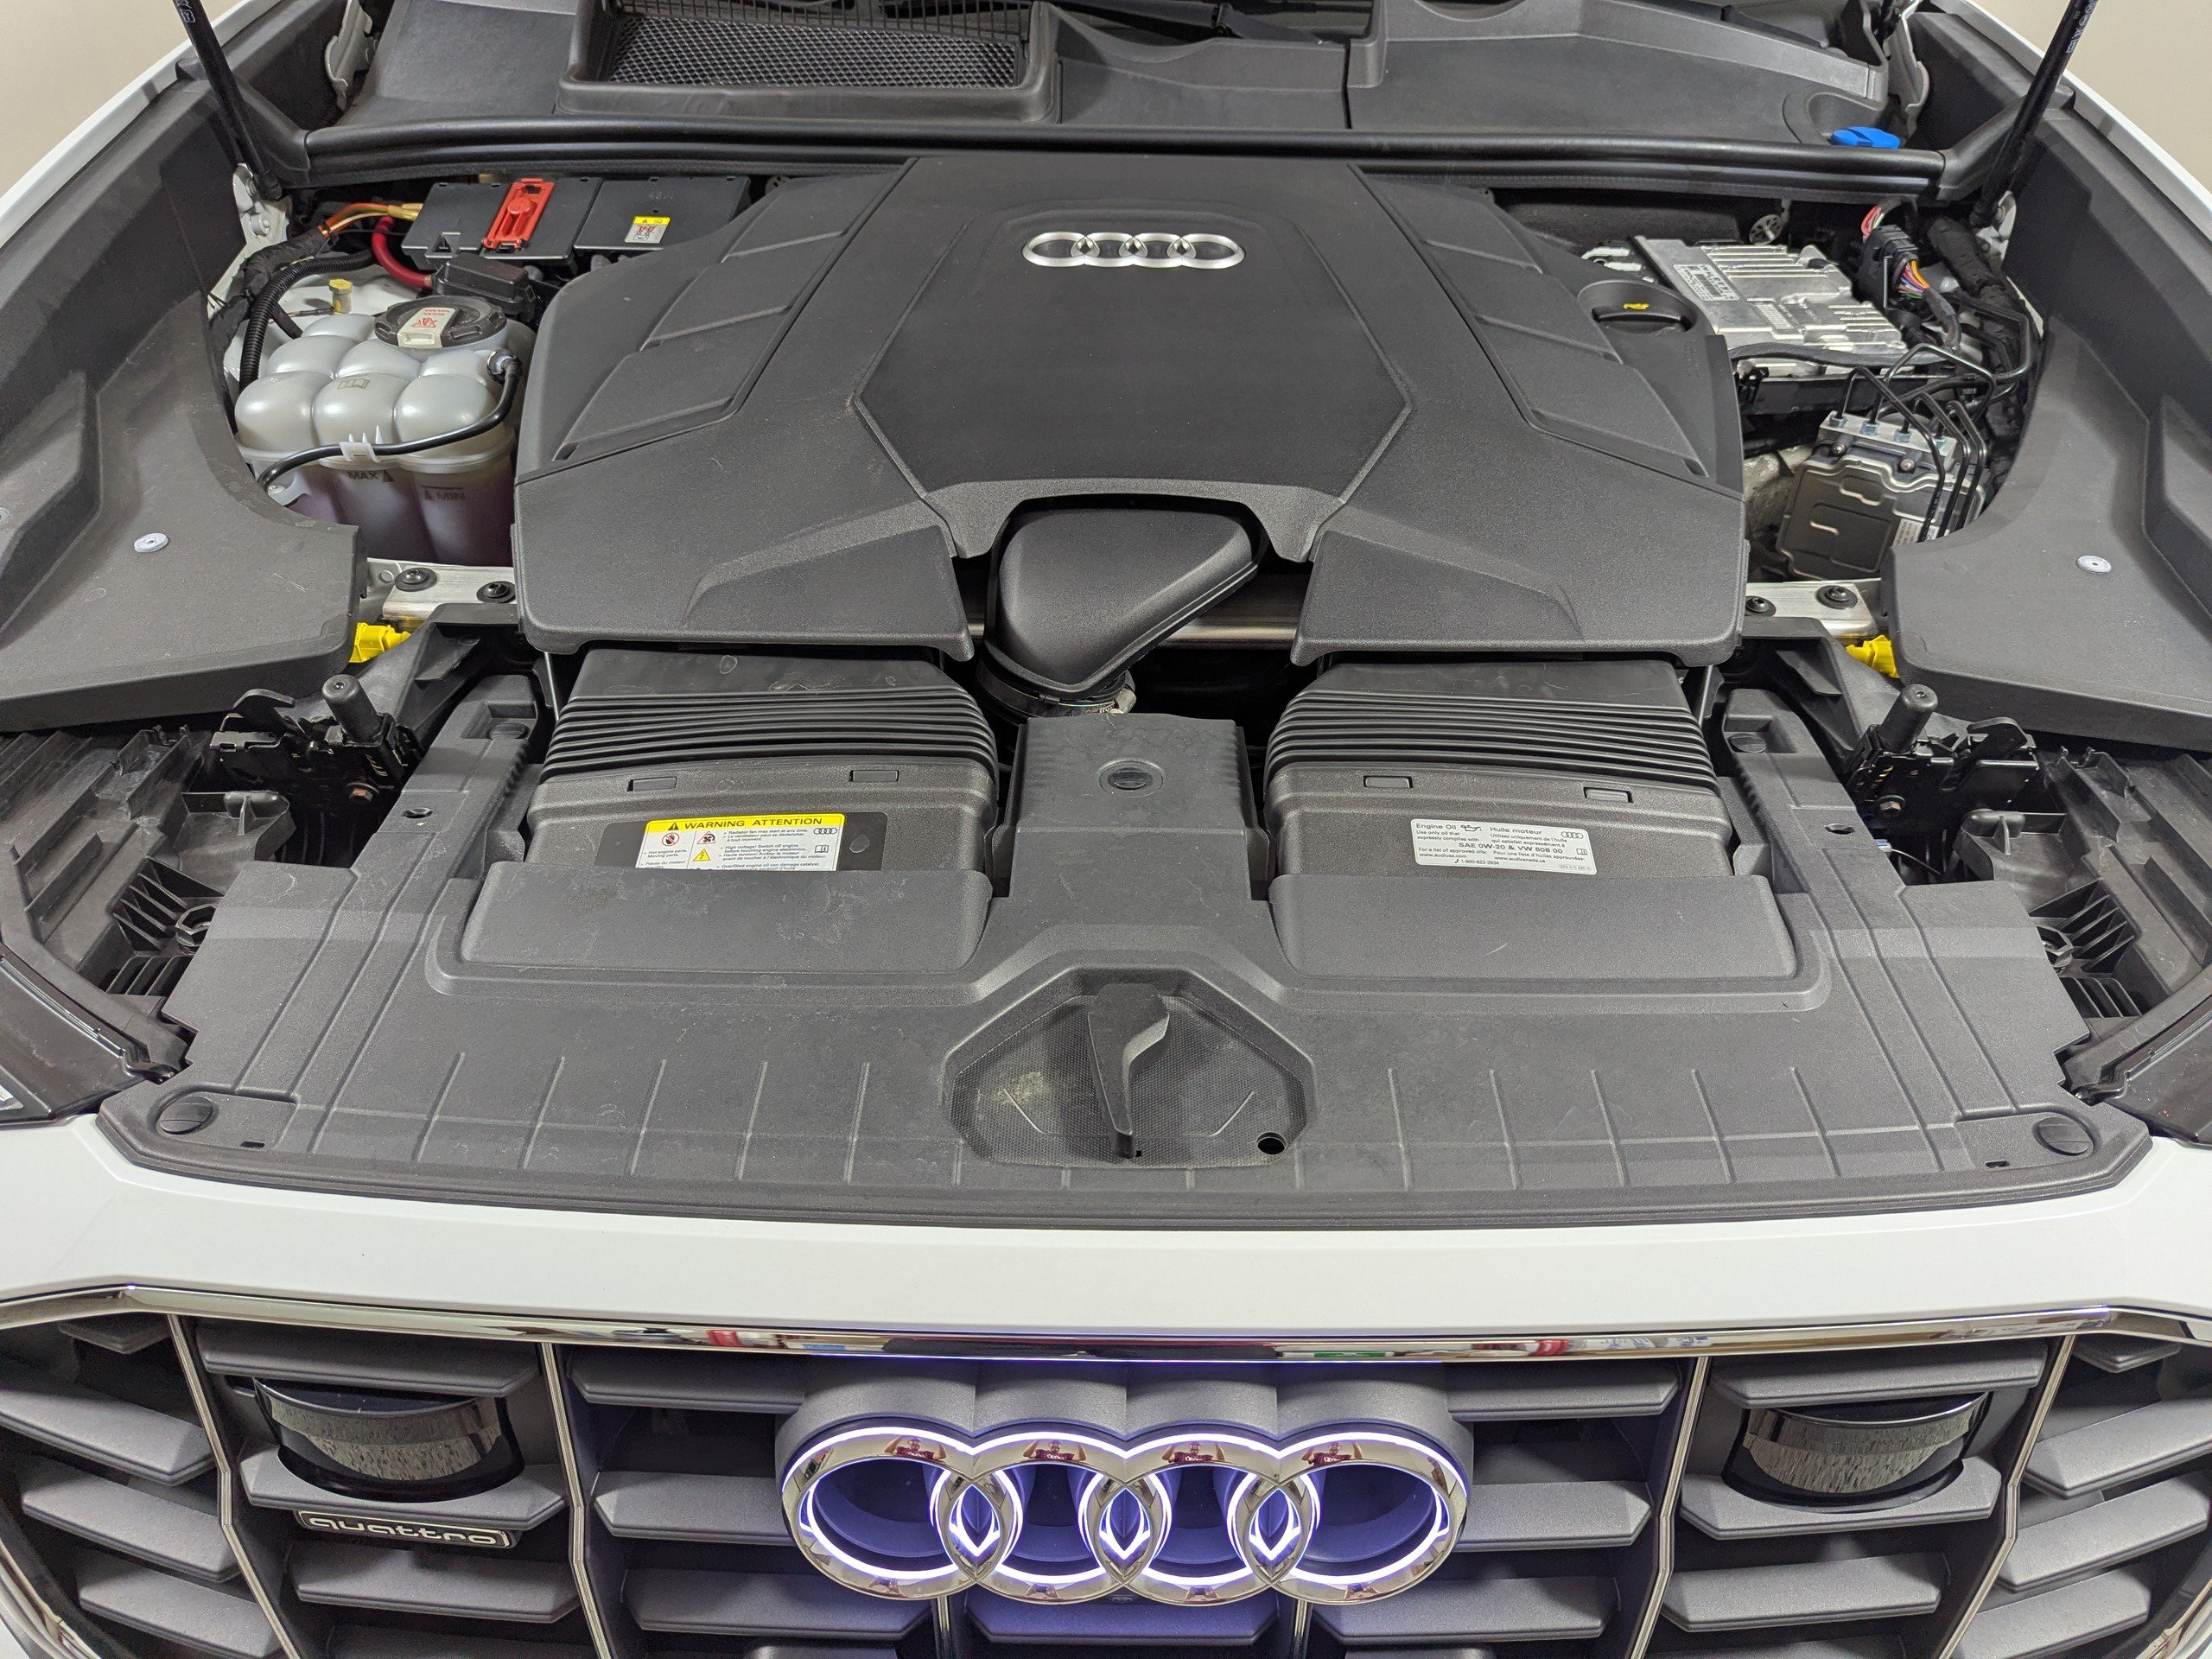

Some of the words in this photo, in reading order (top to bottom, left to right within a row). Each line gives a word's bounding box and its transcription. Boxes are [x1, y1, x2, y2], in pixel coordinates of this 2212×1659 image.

[348, 471, 379, 480] MAX
[436, 492, 465, 500] MIN
[752, 818, 823, 827] ATTENTION
[308, 1516, 497, 1546] quattro
